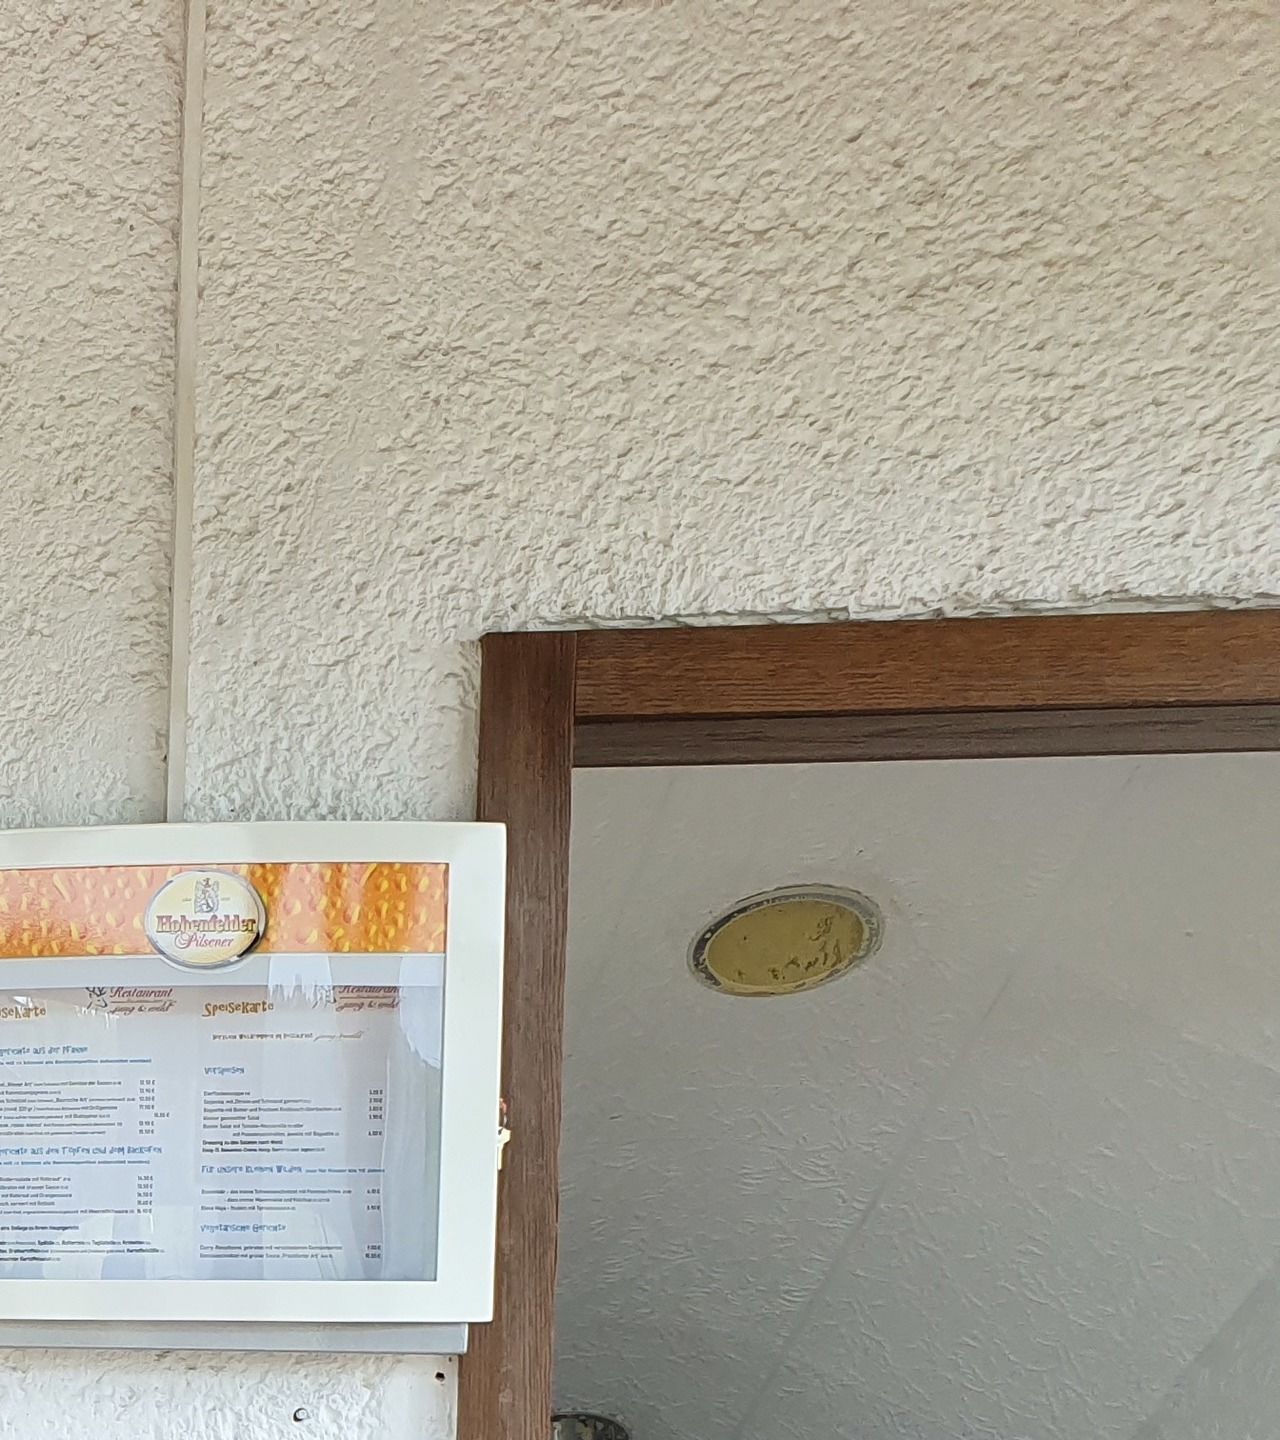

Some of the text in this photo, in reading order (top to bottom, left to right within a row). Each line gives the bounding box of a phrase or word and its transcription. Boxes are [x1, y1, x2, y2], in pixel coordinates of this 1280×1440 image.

[155, 914, 256, 934] Hohenfelder
[174, 932, 235, 949] Pilsener
[109, 986, 173, 998] Restaurant
